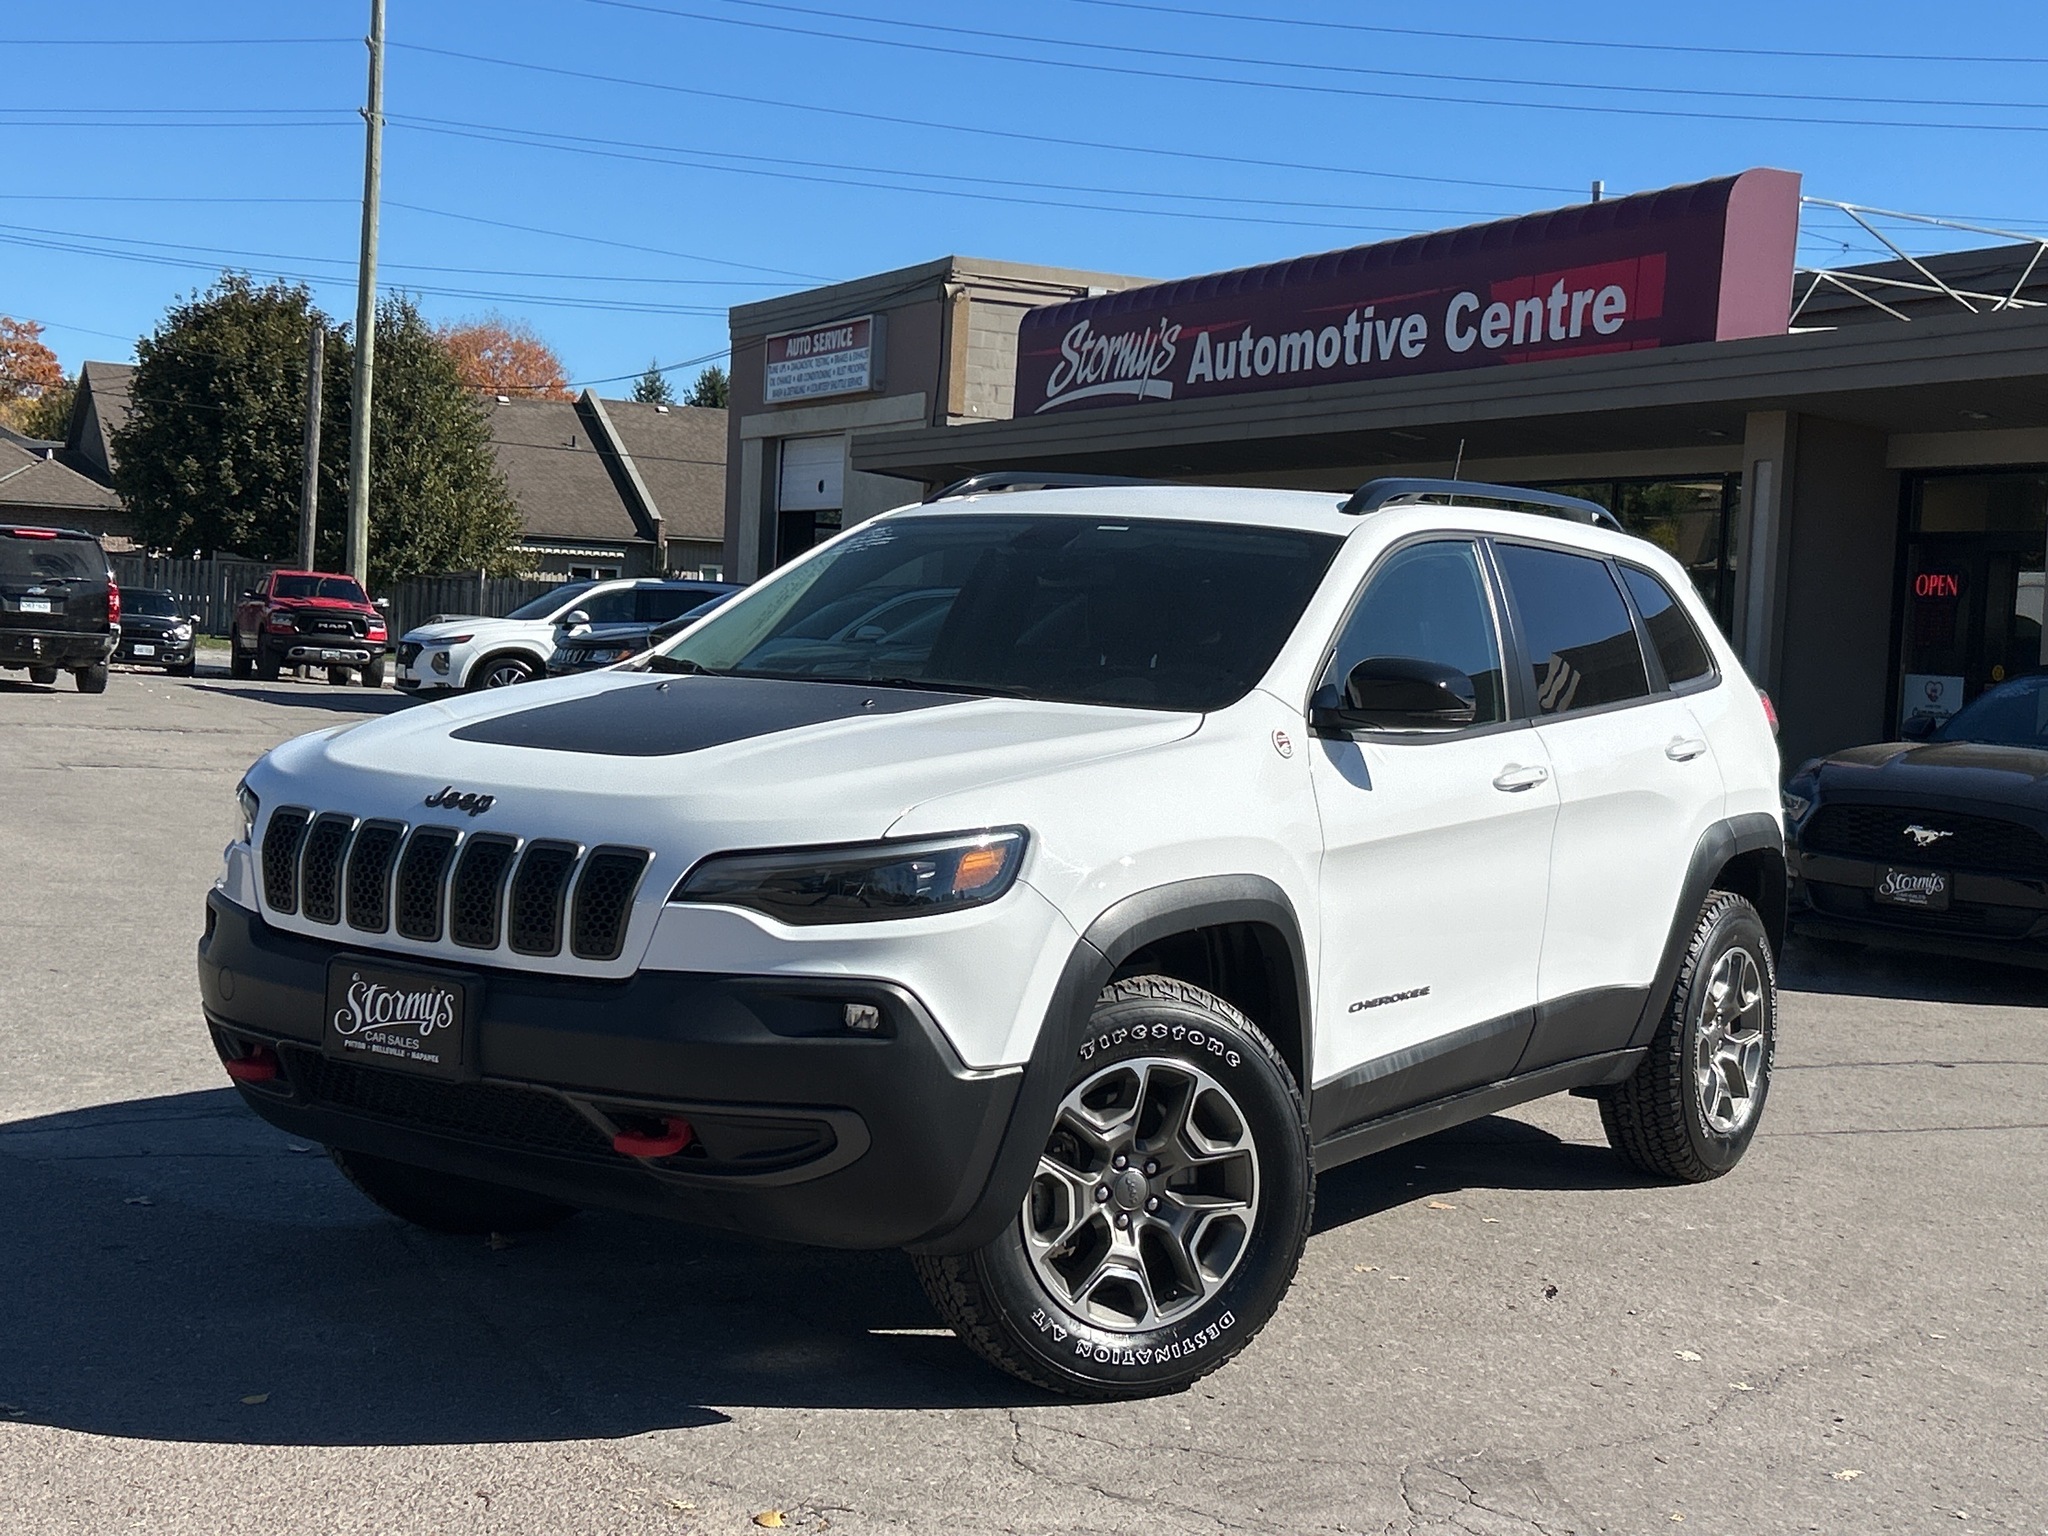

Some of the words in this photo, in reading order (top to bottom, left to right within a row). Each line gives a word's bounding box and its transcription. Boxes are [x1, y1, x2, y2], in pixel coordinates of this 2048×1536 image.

[785, 335, 812, 358] AUTO
[813, 327, 853, 353] SERVICE
[1046, 317, 1182, 400] Stormy's
[1187, 306, 1428, 384] Automotive
[1445, 278, 1627, 353] Centre
[1915, 574, 1958, 596] OPEN
[425, 785, 494, 817] Jeep
[334, 980, 454, 1036] Stormy's
[1348, 985, 1431, 1013] CHEROKEE
[365, 1030, 387, 1044] CAR
[387, 1034, 420, 1049] SALES
[1031, 1307, 1068, 1342] A/T
[1075, 1310, 1236, 1366] DESTINATION
